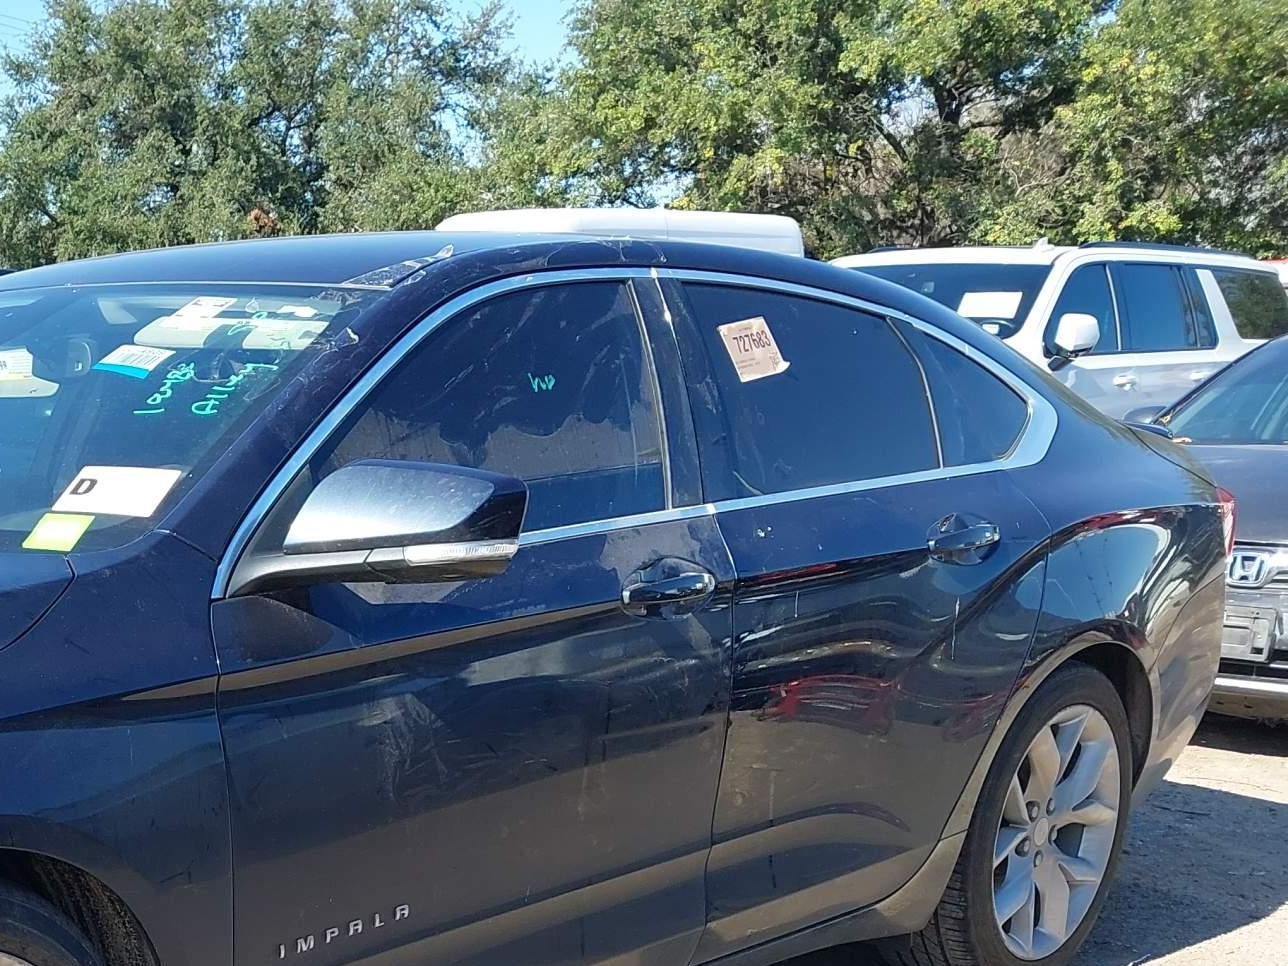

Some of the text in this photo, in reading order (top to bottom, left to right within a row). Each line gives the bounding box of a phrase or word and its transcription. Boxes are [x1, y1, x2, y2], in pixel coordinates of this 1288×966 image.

[732, 329, 772, 355] 727683
[69, 478, 98, 496] D
[278, 904, 410, 959] IMPALA
